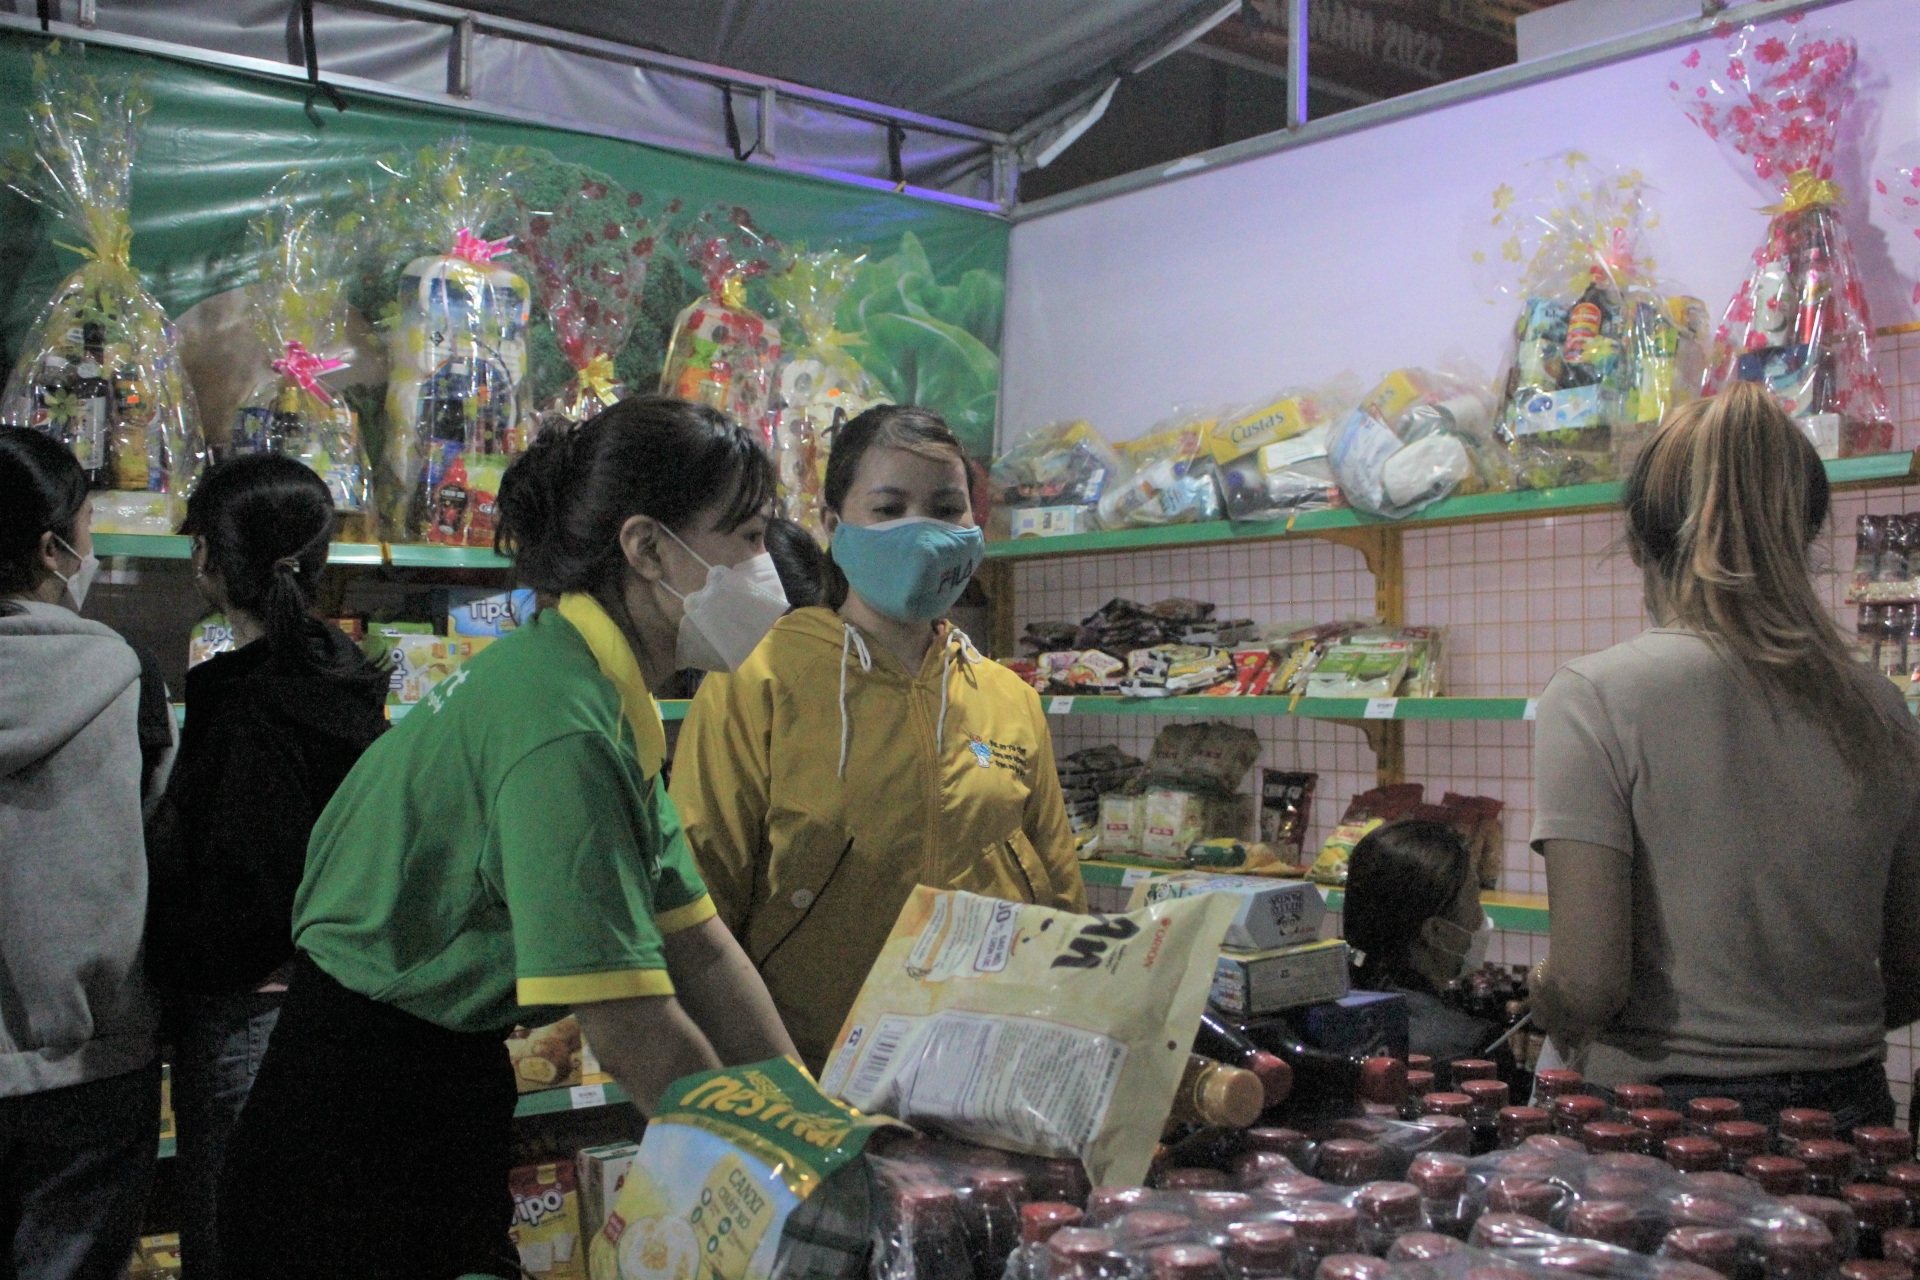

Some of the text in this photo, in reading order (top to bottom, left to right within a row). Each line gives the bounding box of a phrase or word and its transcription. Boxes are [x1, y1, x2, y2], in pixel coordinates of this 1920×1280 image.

[1230, 408, 1285, 444] Custas
[937, 557, 973, 594] FILA
[467, 600, 516, 625] Tipo
[1143, 928, 1167, 969] ORION
[511, 1188, 563, 1228] ipo
[728, 1166, 767, 1216] CANXI
